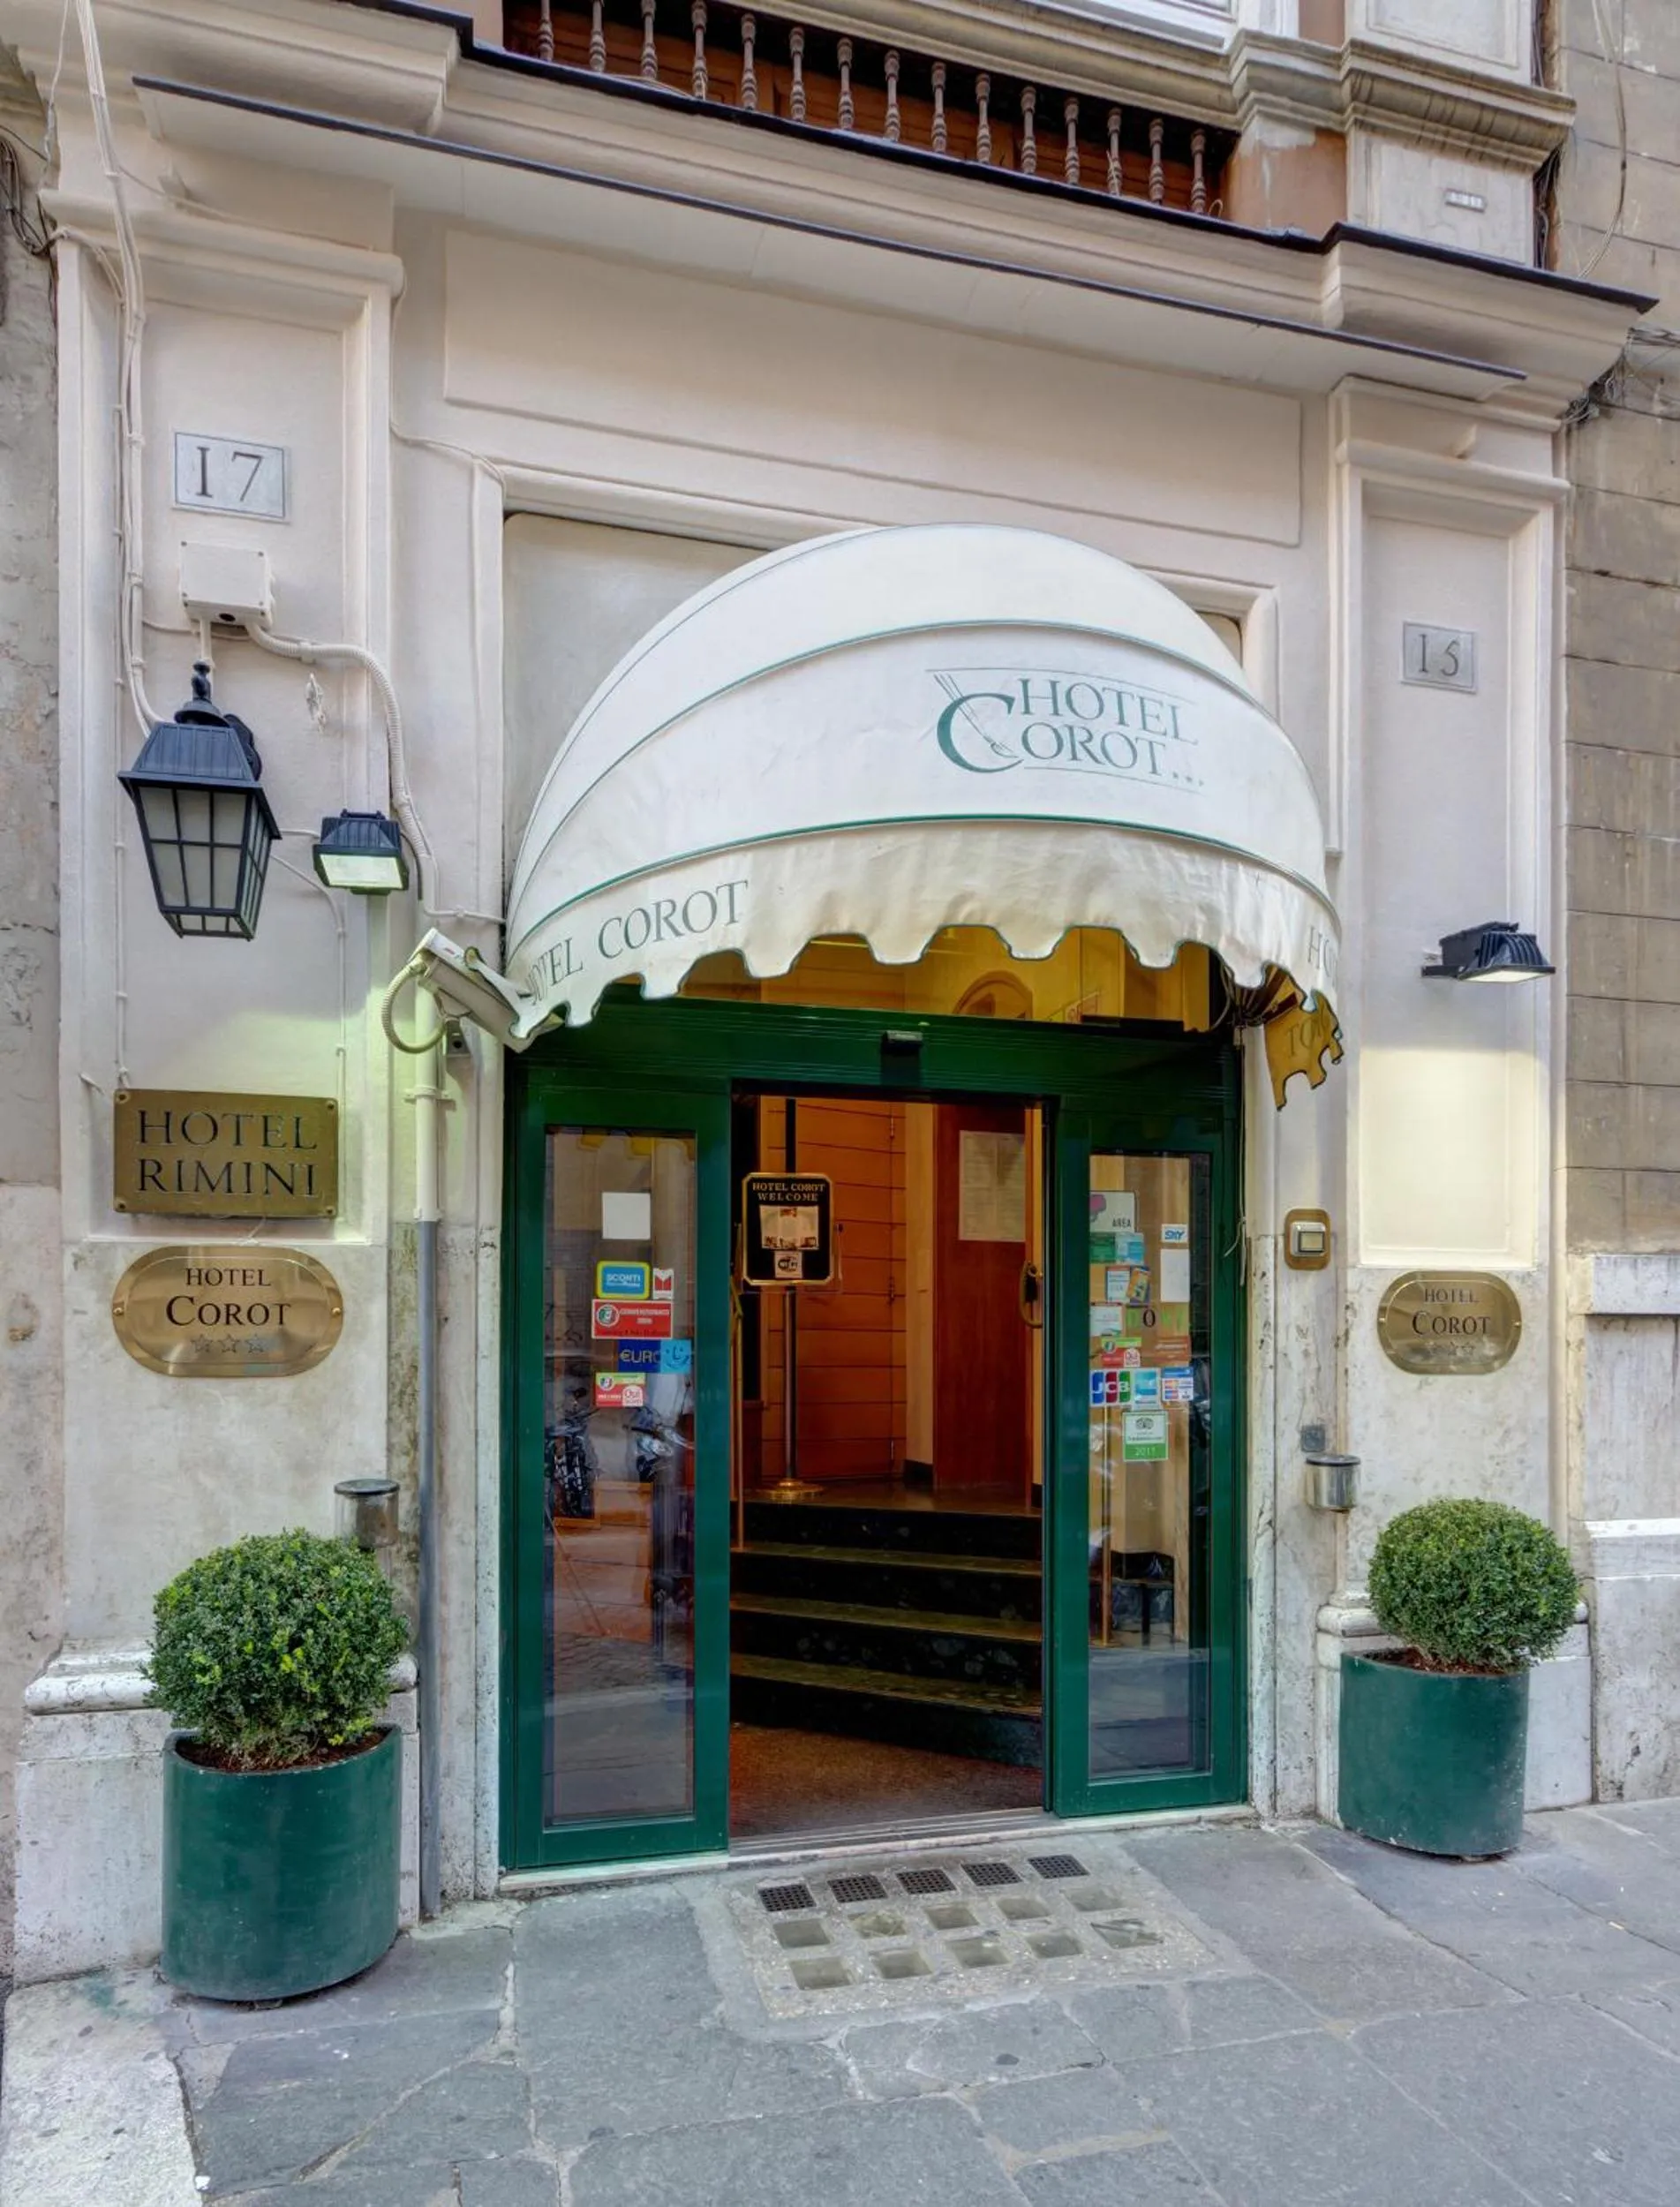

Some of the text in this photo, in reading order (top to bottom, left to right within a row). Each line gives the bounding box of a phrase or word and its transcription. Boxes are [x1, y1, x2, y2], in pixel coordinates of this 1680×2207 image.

[195, 445, 264, 502] 17
[1418, 633, 1460, 677] 15
[1017, 677, 1199, 746] HOTEL
[598, 880, 749, 960] COROT
[136, 1109, 318, 1150] HOTEL
[138, 1157, 317, 1196] RIMINI
[752, 1182, 788, 1192] HOTEL
[757, 1192, 819, 1201] WELCOME
[1111, 1217, 1132, 1228] AREA
[185, 1267, 272, 1287] HOTEL
[166, 1295, 292, 1327] COROT
[1424, 1288, 1480, 1303] HOTEL
[1412, 1310, 1491, 1336] COROT
